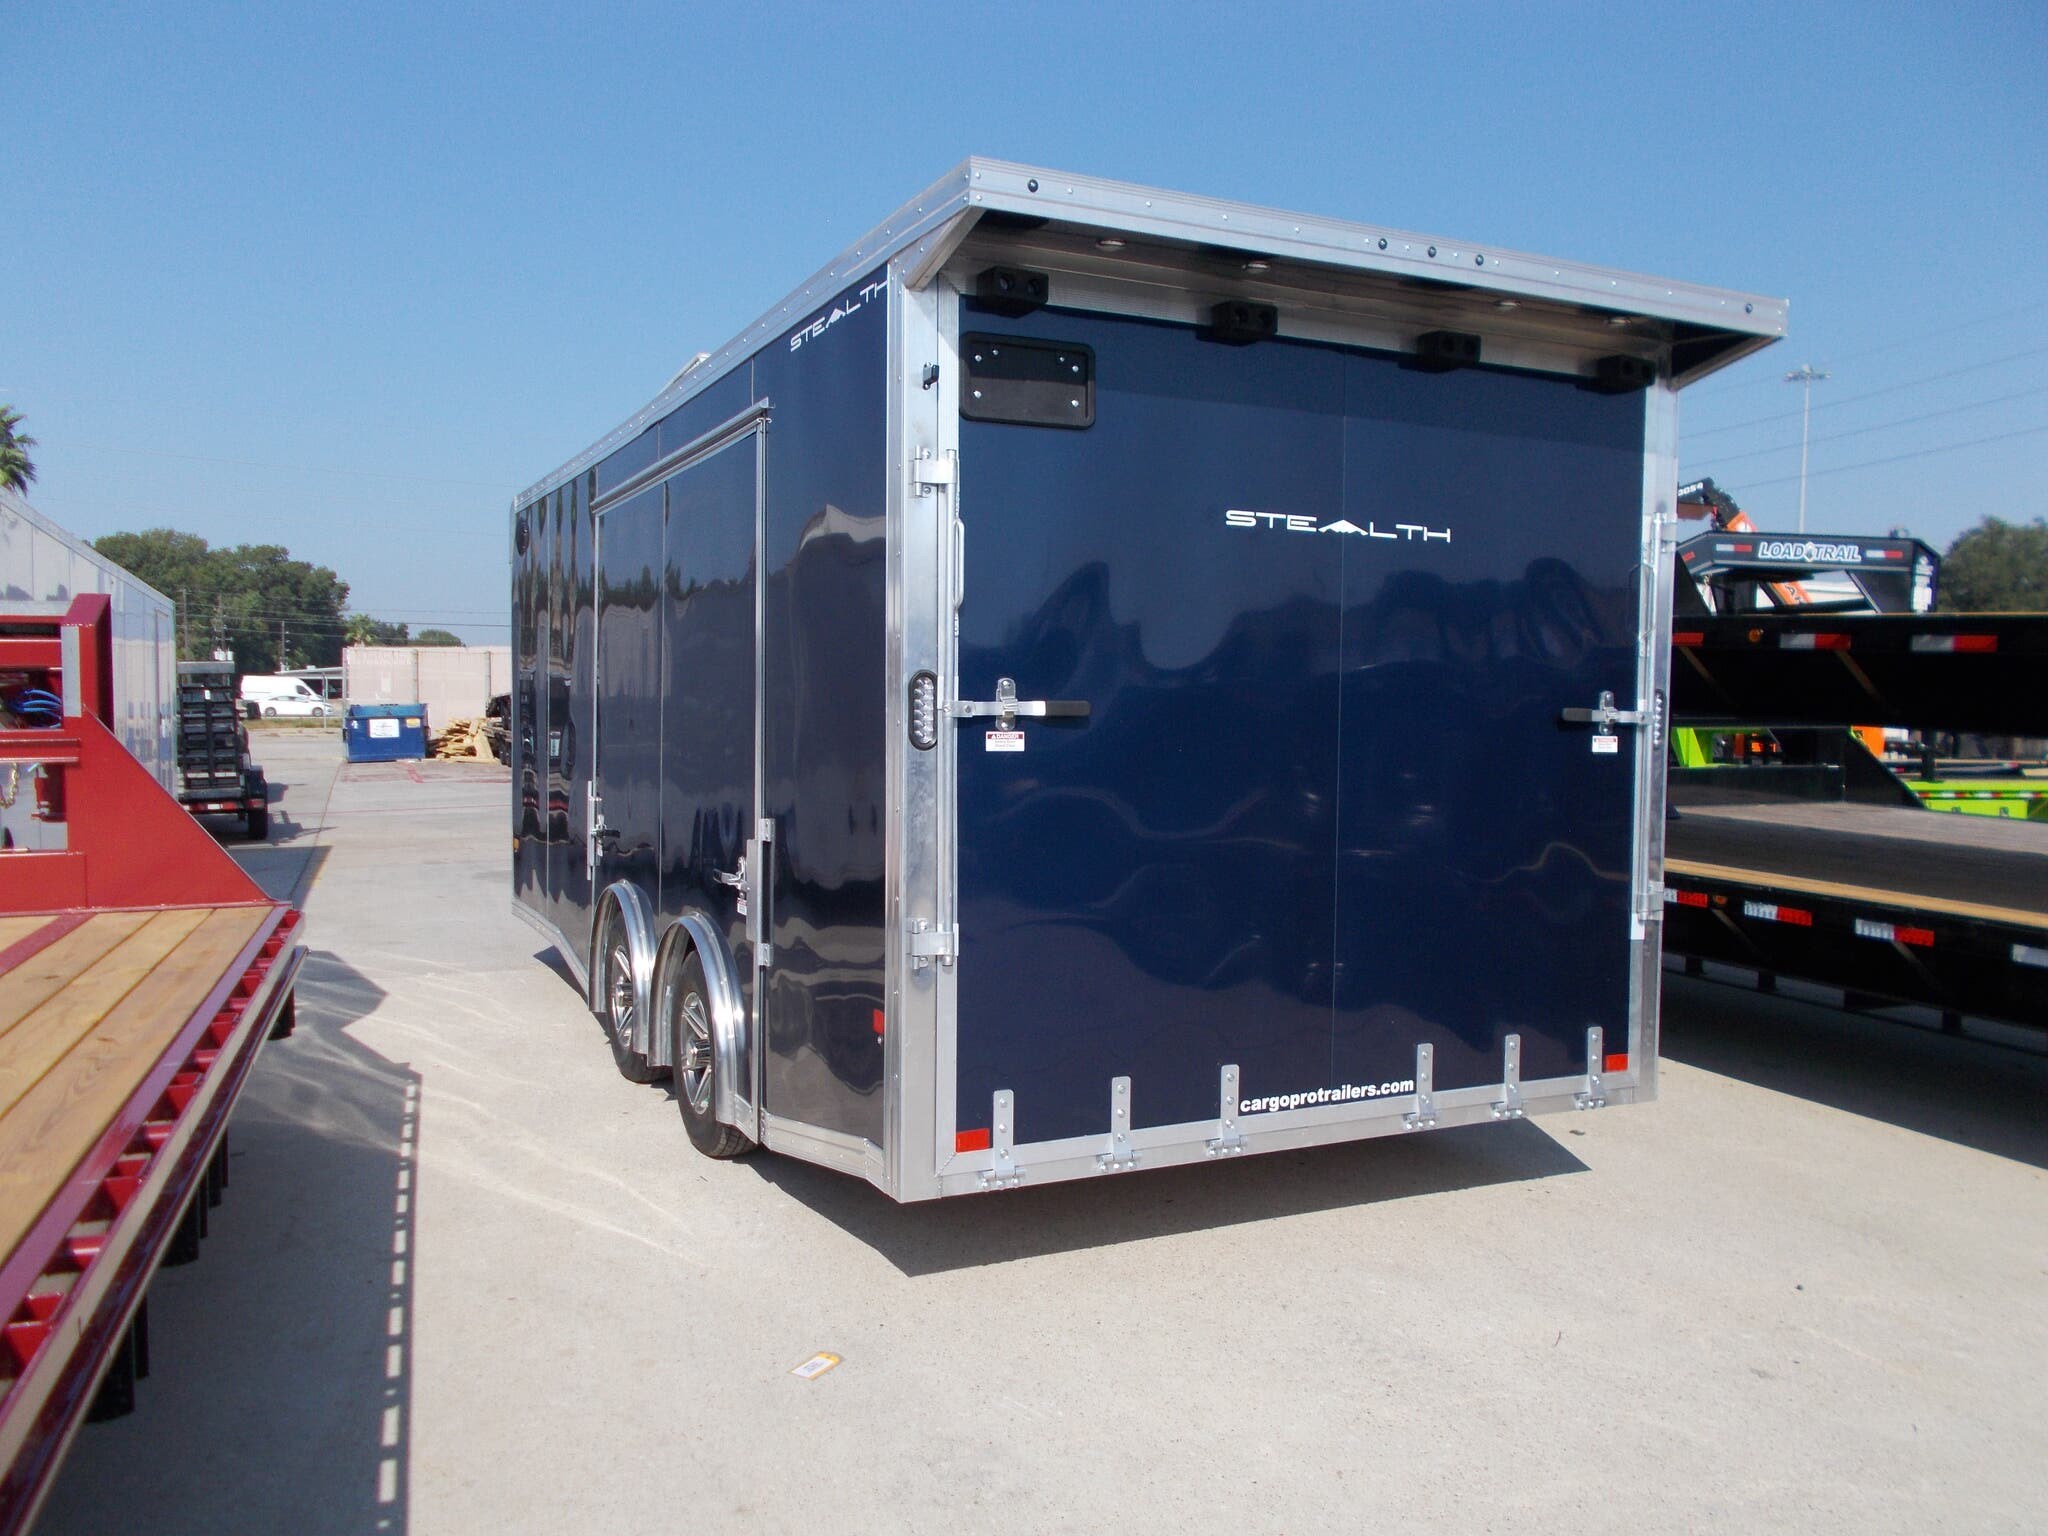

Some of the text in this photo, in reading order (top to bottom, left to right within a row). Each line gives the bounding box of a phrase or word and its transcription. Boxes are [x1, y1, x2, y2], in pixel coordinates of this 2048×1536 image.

[790, 280, 888, 352] STEALTH
[1226, 510, 1451, 543] STEALTH
[1758, 541, 1862, 562] LOAD TRAIL
[1240, 1079, 1414, 1112] cargoprotrailers.com
